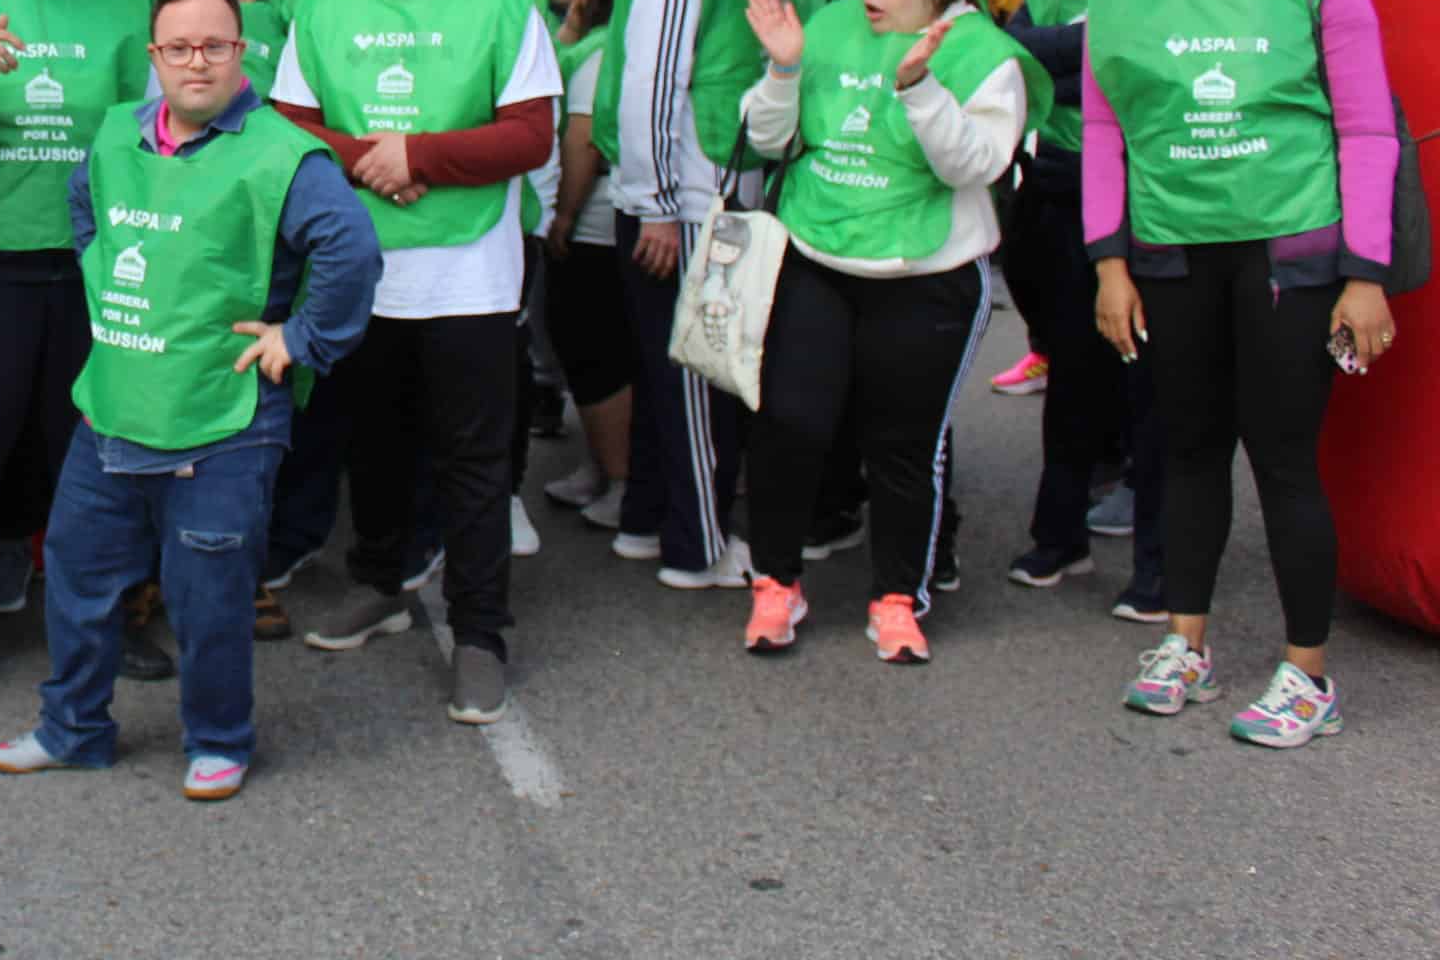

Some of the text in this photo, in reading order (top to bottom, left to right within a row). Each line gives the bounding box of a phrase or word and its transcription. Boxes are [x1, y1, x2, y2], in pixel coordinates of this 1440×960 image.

[15, 114, 74, 127] CARRERA
[368, 119, 414, 131] POR LA
[23, 129, 68, 142] POR LA
[1191, 127, 1217, 139] POR
[123, 312, 141, 328] LA
